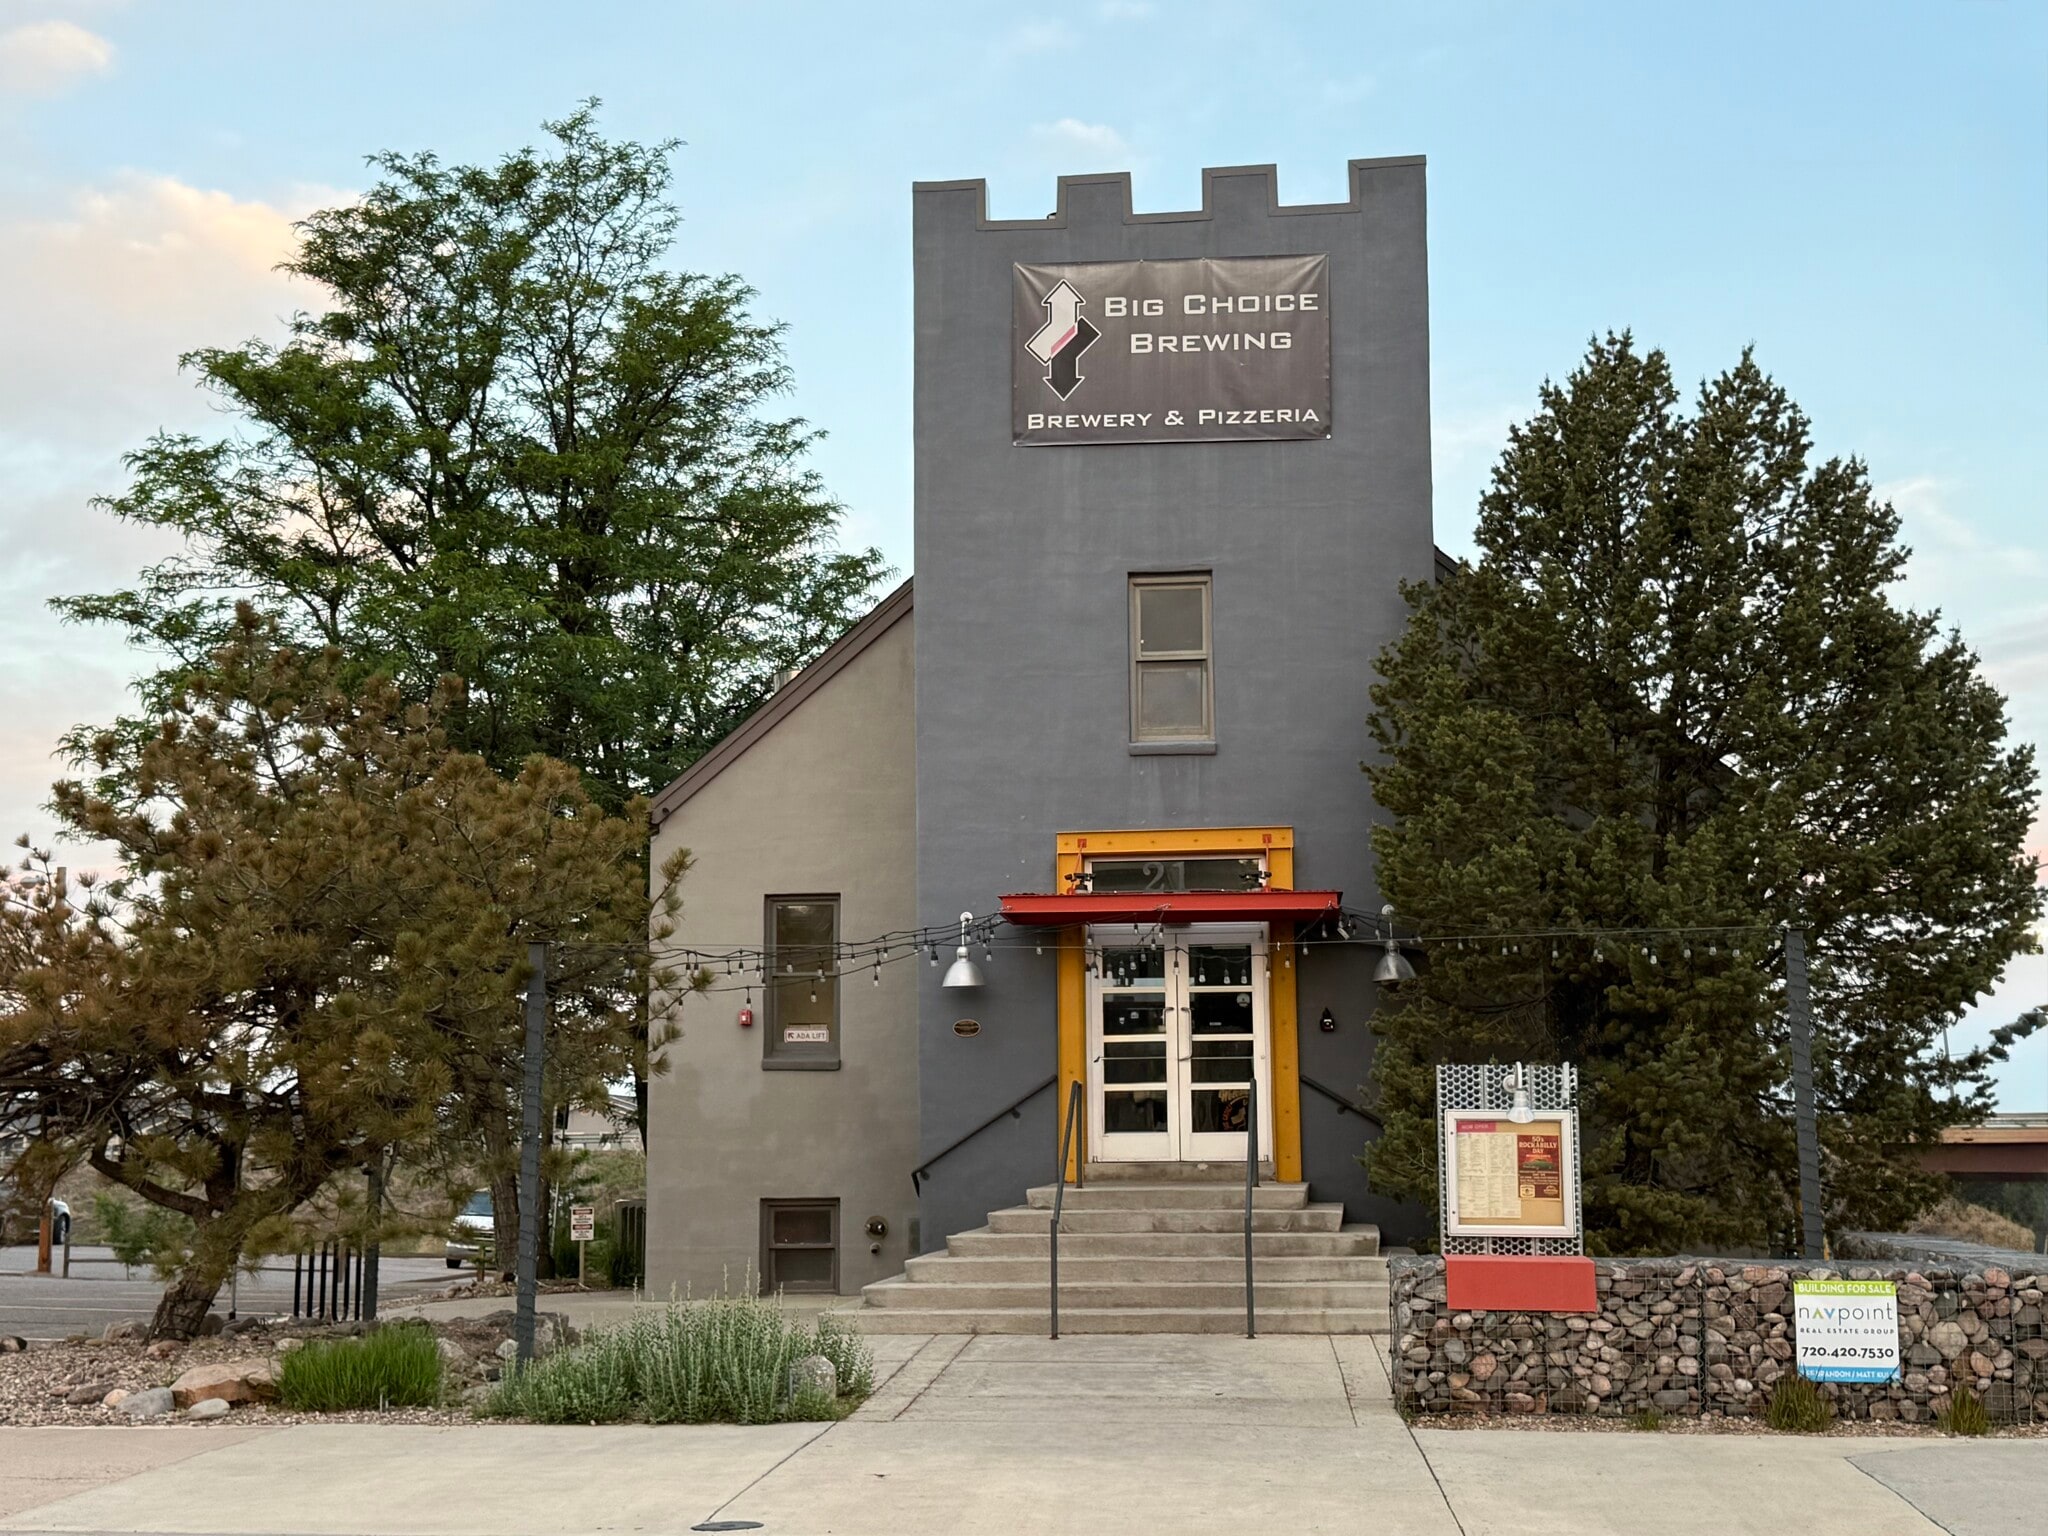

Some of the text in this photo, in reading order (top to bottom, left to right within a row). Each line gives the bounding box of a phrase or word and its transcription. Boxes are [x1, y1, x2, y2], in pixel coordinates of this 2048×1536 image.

[1105, 293, 1319, 317] BIG CHOICE
[1130, 332, 1292, 354] BREWING
[1027, 408, 1320, 430] BREWERY & PIZZERIA
[1799, 1284, 1892, 1294] BUILDING FOR SALE
[1802, 1347, 1894, 1359] 720.420.7530
